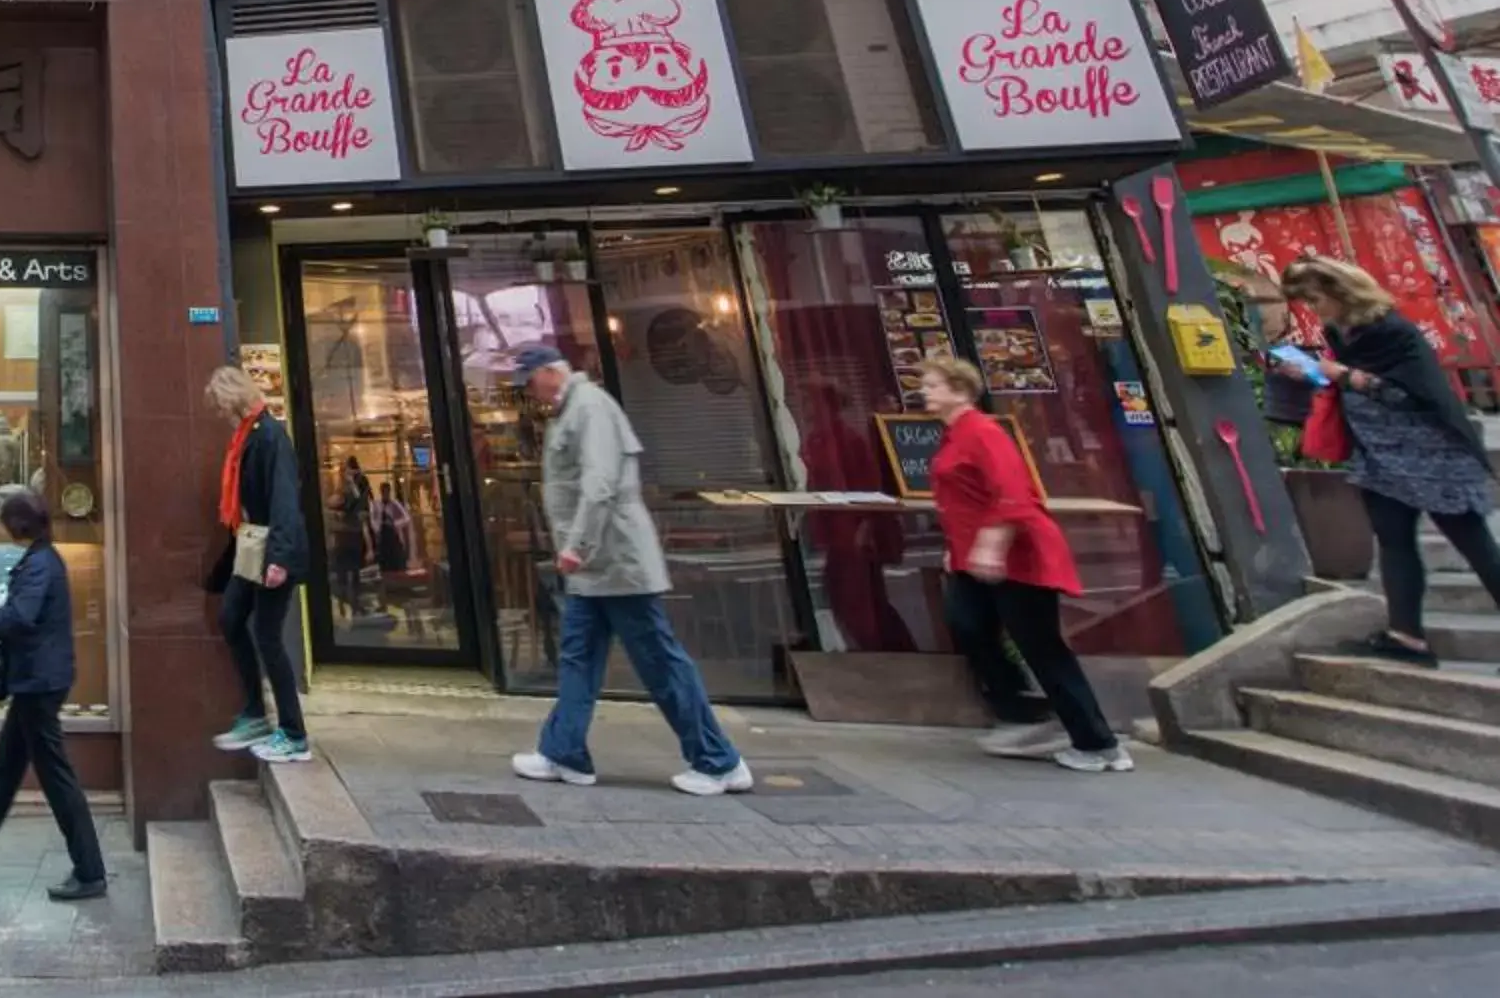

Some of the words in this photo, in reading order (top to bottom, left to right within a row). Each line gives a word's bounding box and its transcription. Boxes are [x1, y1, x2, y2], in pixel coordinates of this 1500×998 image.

[281, 48, 336, 86] La
[959, 20, 1133, 83] Grande
[1190, 33, 1276, 98] RESTAURANT
[241, 73, 376, 124] Grande
[984, 65, 1141, 118] Bouffe
[257, 113, 373, 159] Bouffe
[23, 258, 89, 281] Arts
